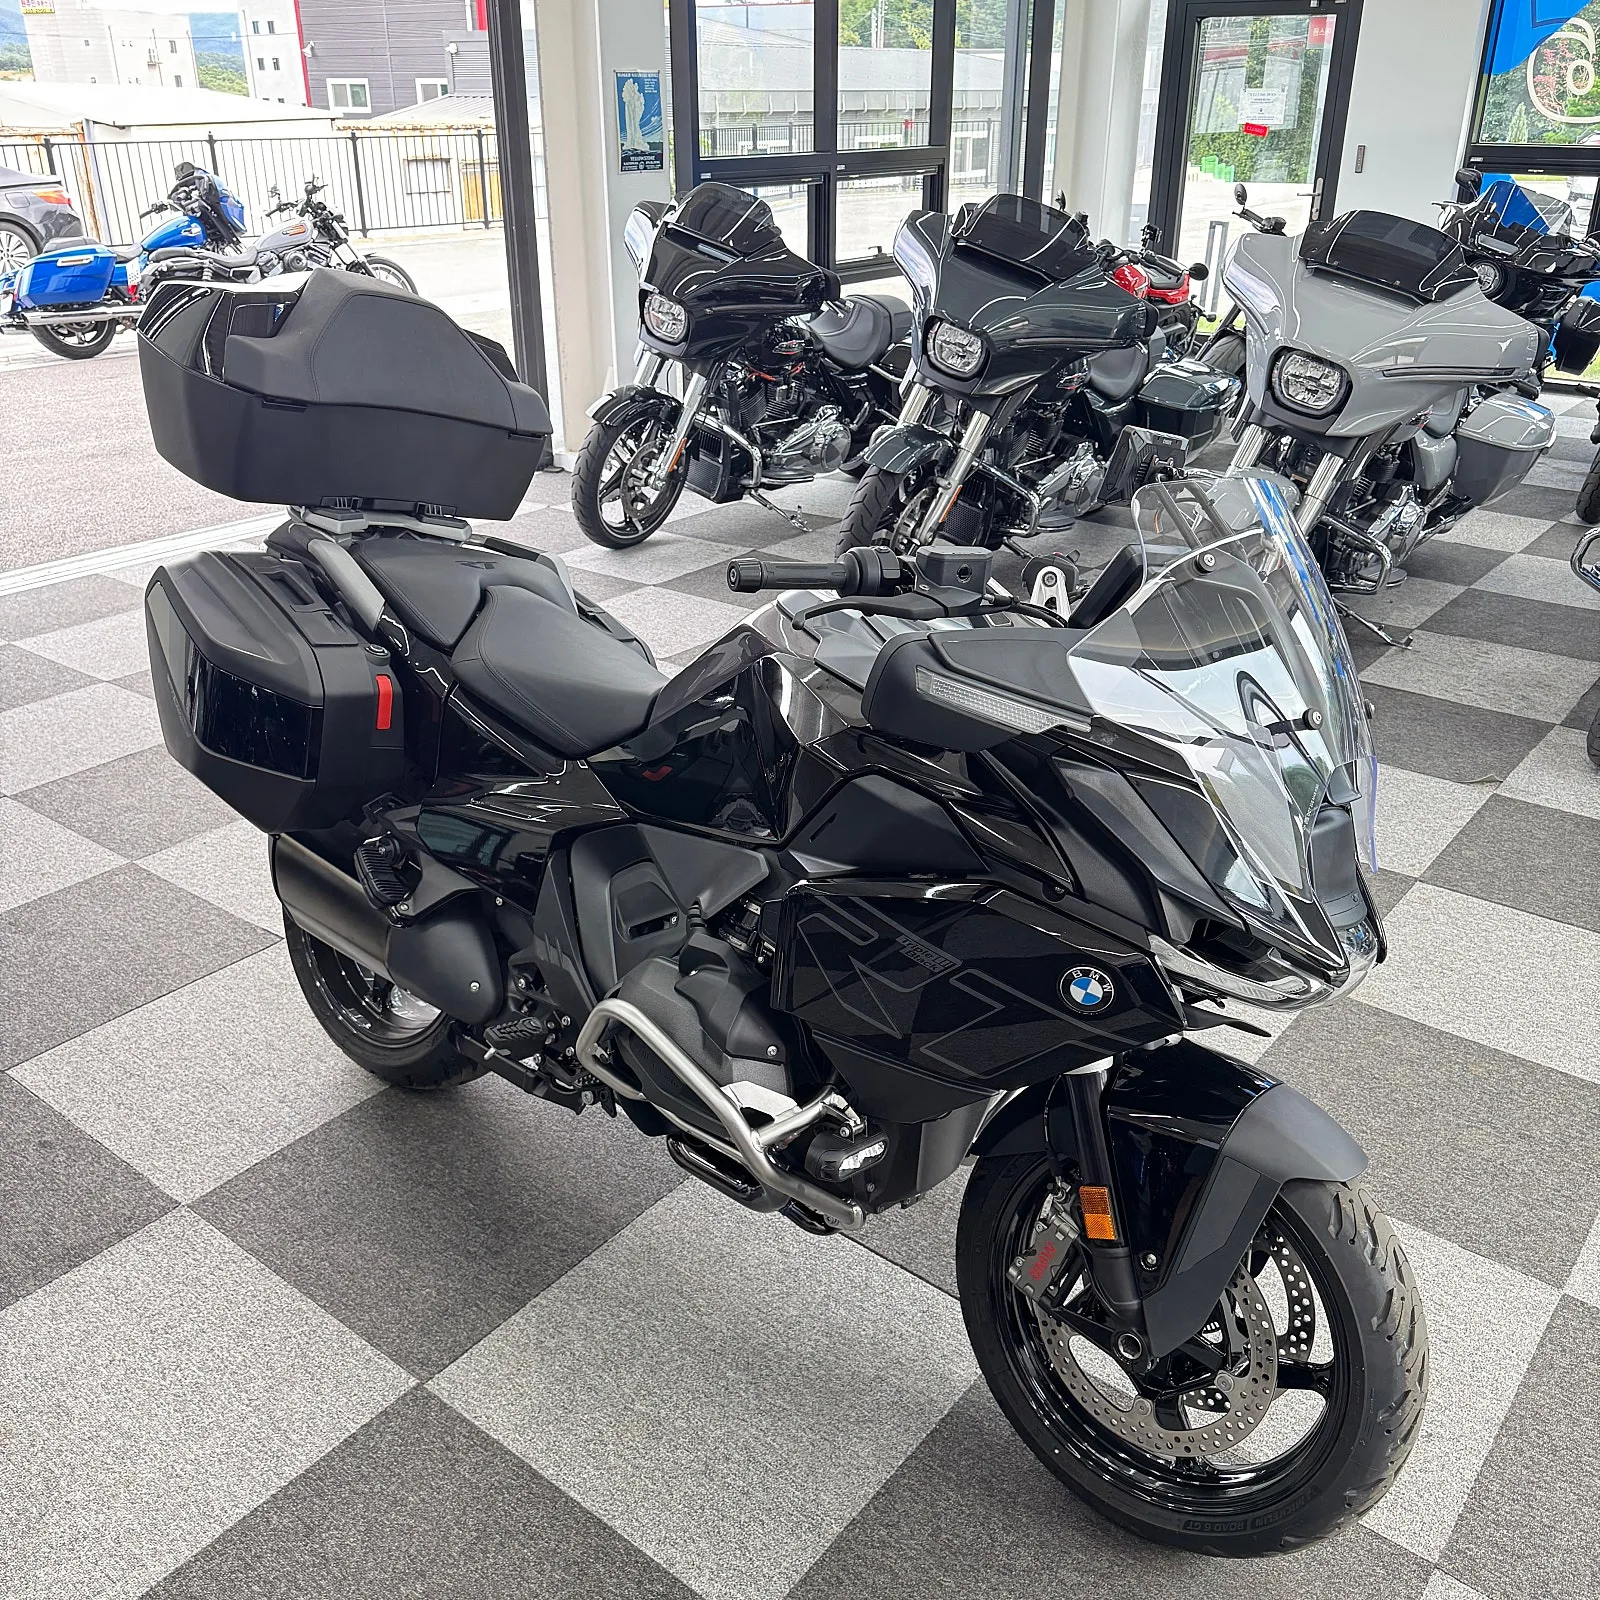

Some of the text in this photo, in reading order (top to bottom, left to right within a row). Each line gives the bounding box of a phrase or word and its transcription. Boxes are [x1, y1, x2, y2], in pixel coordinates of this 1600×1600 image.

[900, 936, 933, 960] Triple
[904, 947, 939, 973] Black
[1071, 970, 1112, 993] BMW
[1029, 1240, 1056, 1281] BMW
[1186, 1521, 1245, 1532] ROAD 6 GT
